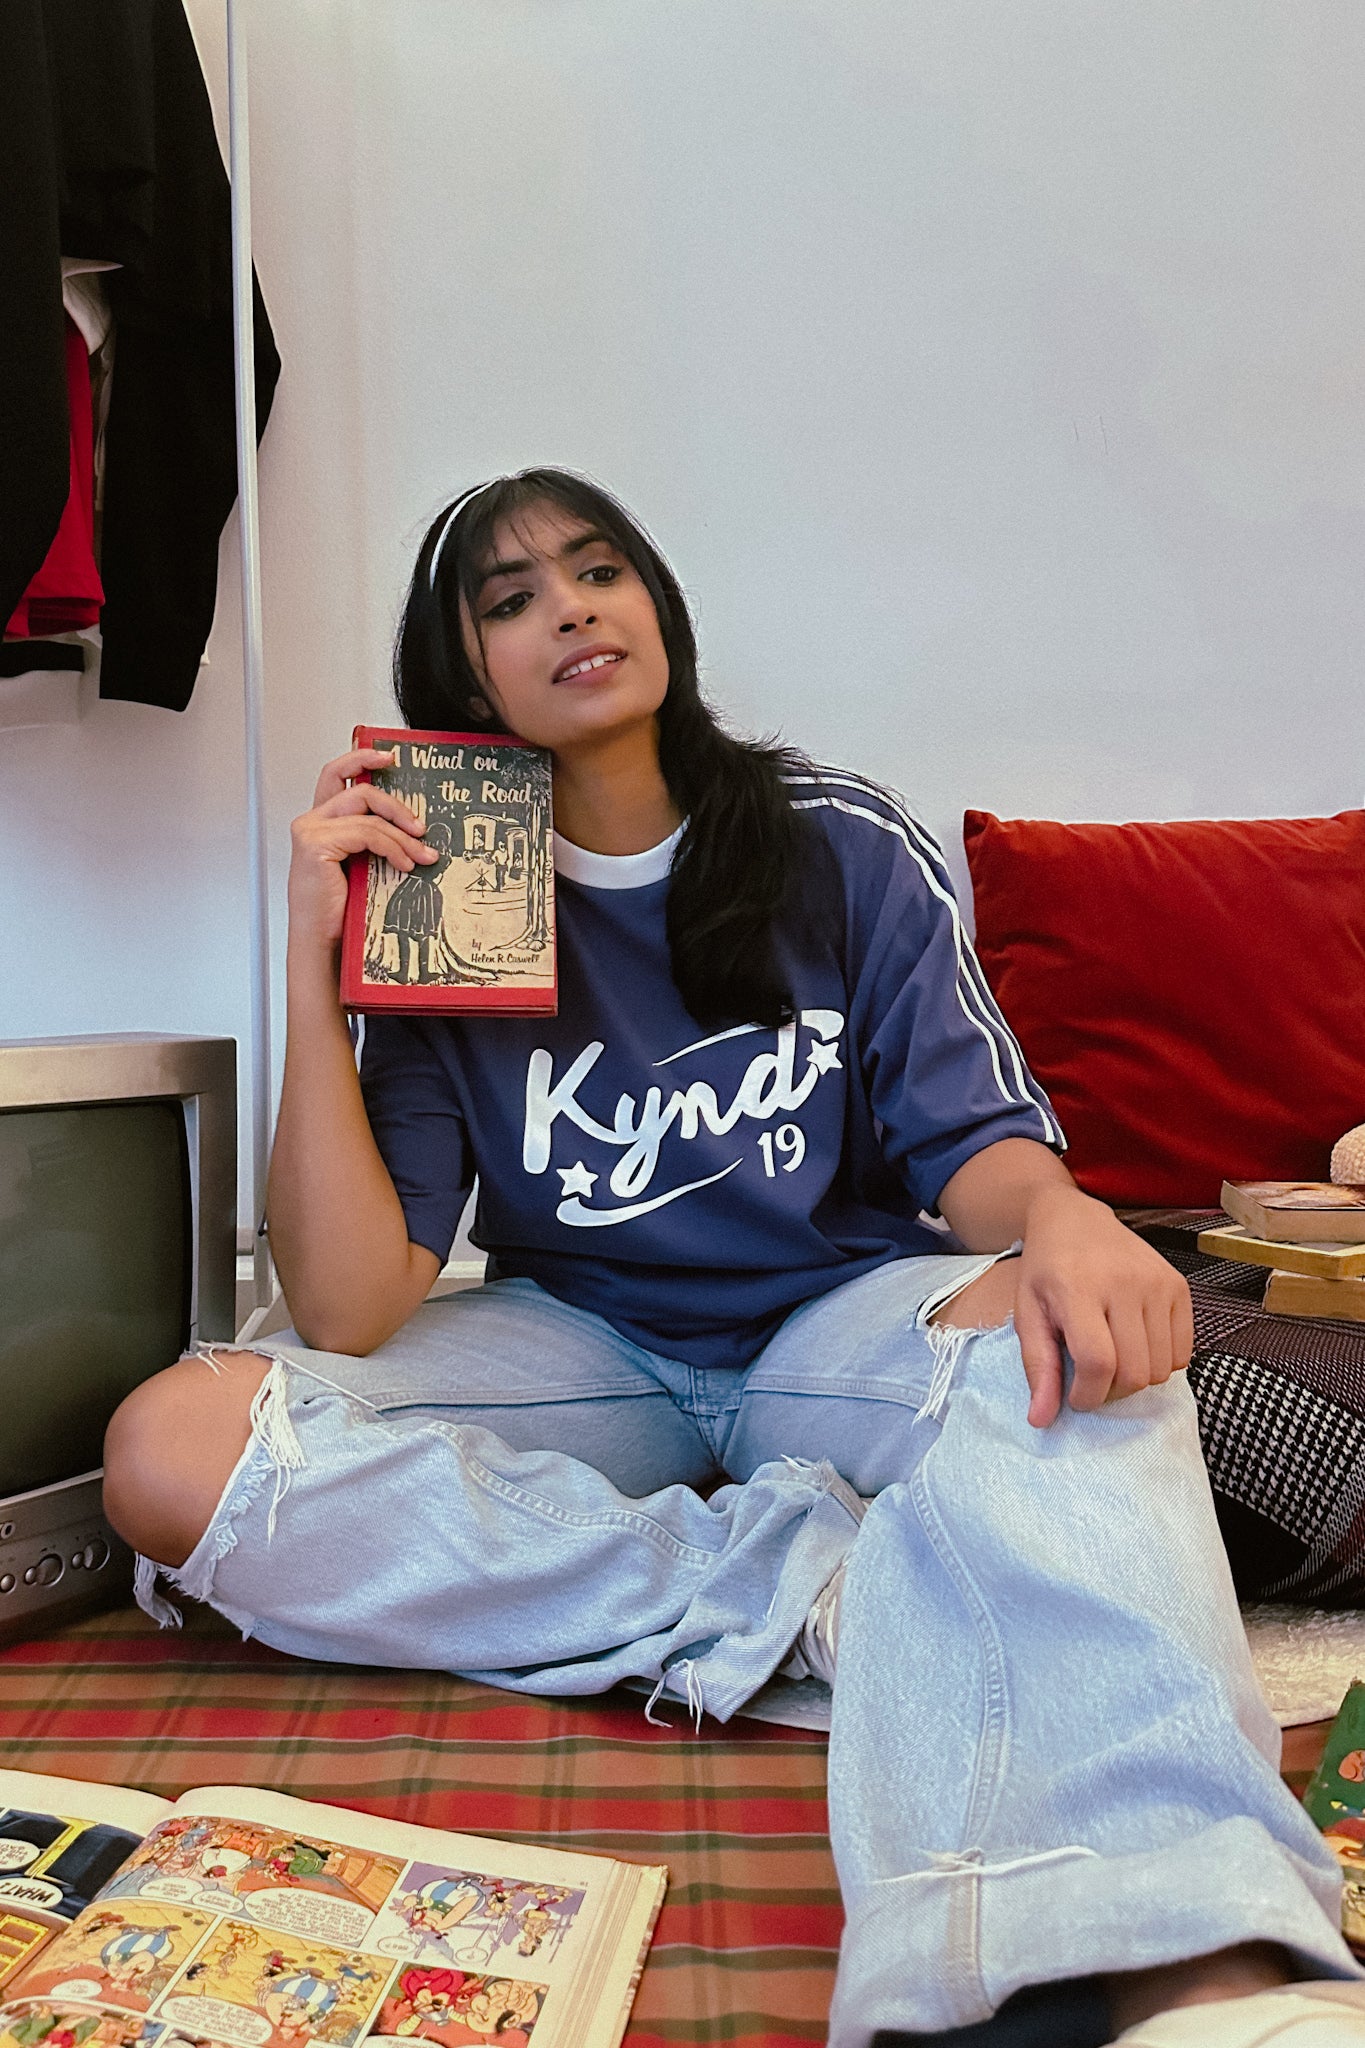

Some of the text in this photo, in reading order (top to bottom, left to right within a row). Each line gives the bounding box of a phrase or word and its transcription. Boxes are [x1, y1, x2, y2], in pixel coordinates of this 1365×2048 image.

[411, 745, 466, 770] Wind
[473, 754, 501, 772] on
[437, 780, 534, 804] the Road
[471, 938, 482, 951] by
[471, 953, 496, 964] Helen
[523, 1020, 819, 1198] Kynd
[757, 1123, 806, 1178] 19
